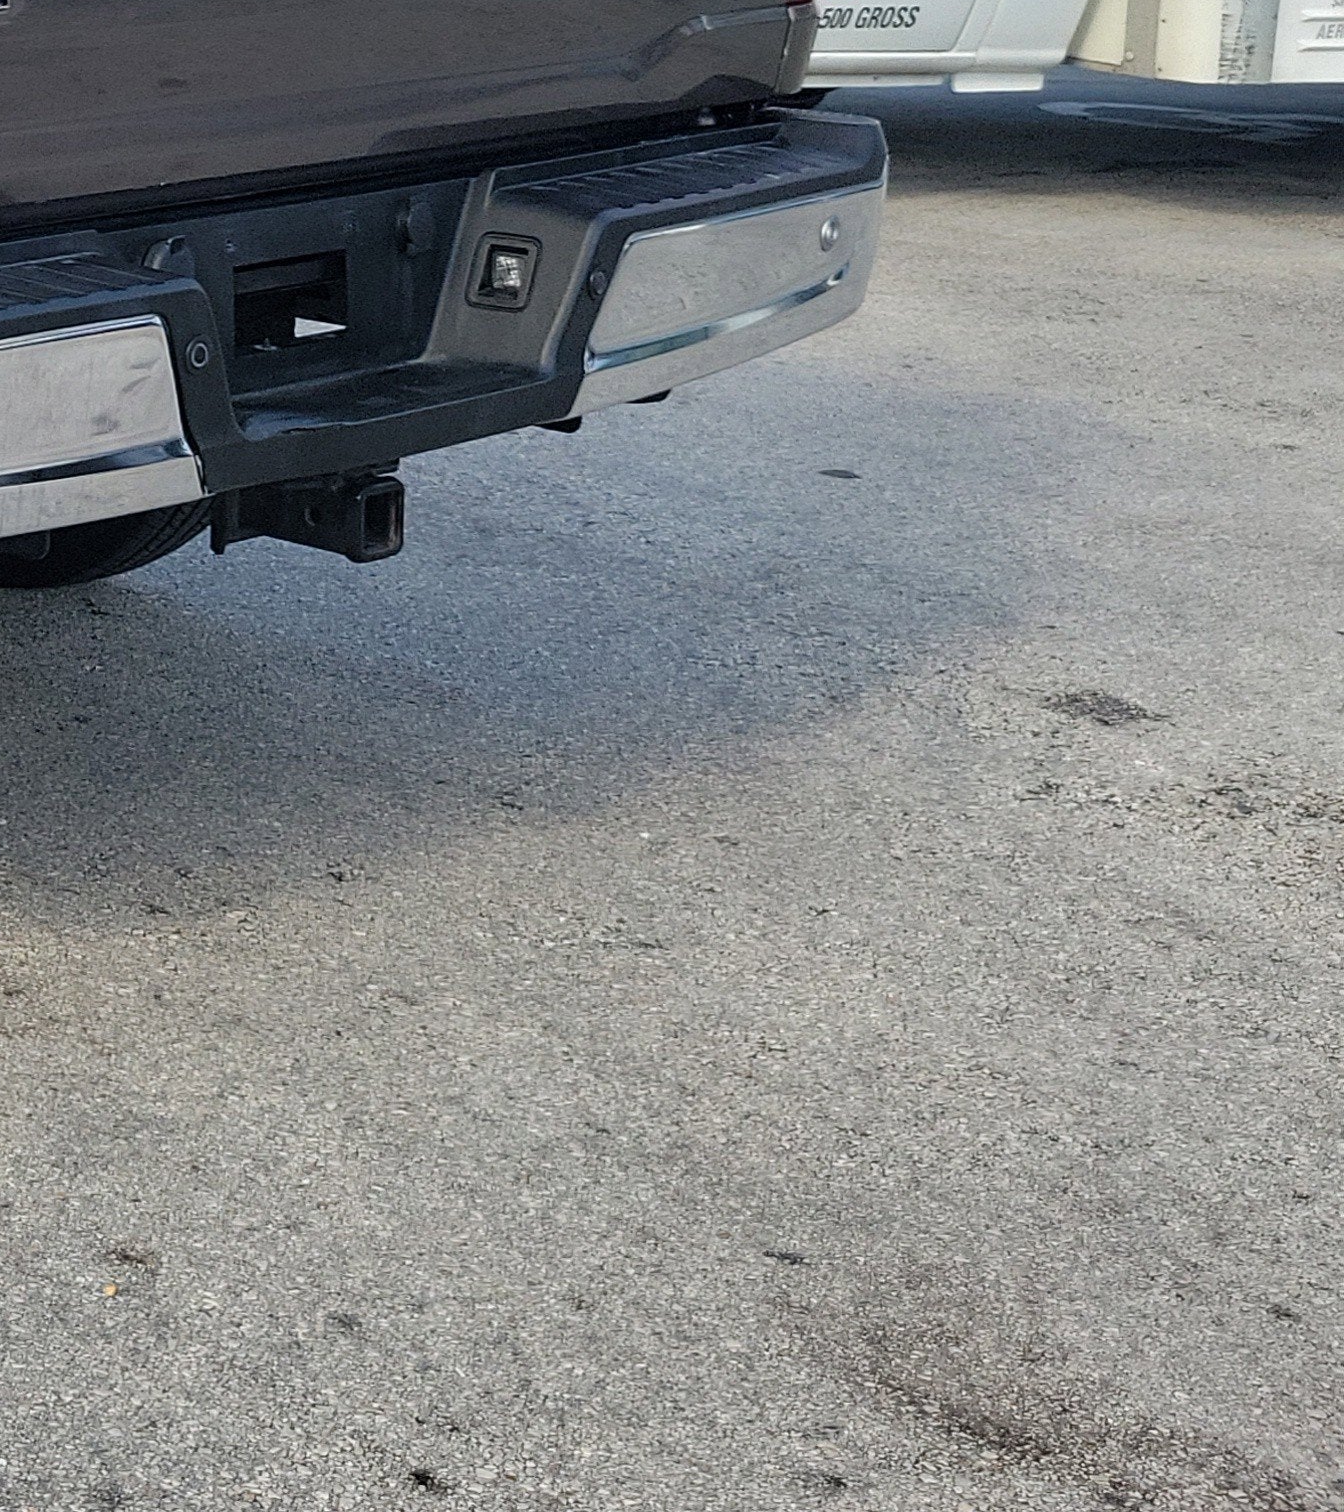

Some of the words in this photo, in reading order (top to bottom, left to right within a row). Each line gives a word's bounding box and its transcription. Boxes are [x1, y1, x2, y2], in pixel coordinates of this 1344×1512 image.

[816, 7, 853, 29] 500
[855, 6, 920, 29] GROSS
[1315, 24, 1344, 39] AER
